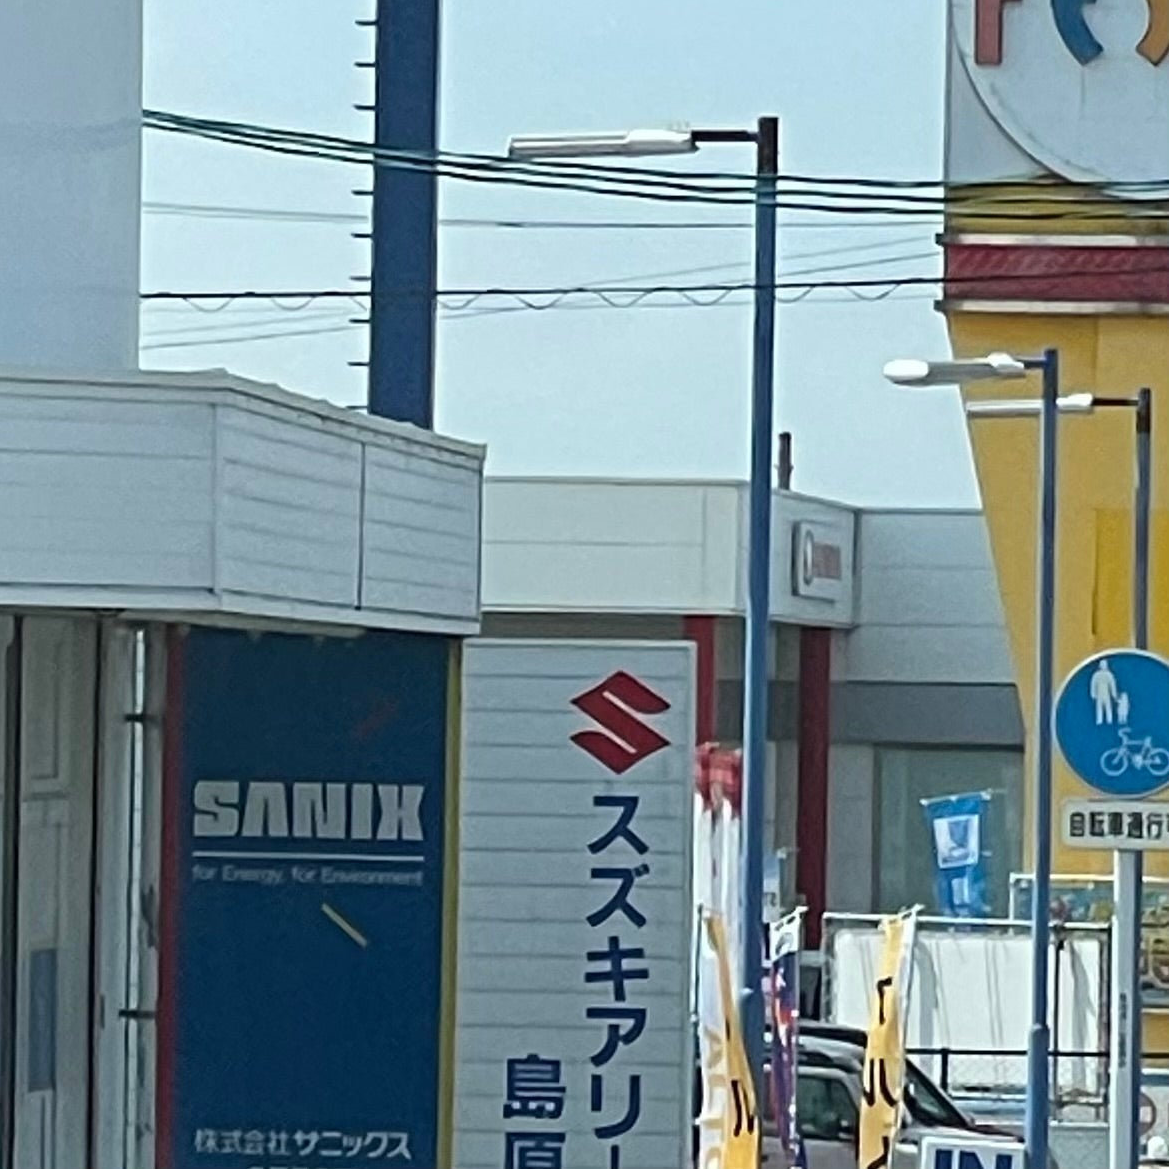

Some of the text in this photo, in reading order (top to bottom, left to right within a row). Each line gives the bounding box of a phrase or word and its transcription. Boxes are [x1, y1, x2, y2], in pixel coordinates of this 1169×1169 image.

[193, 781, 425, 842] SANIX
[1069, 811, 1169, 840] 自転車通行
[194, 1128, 412, 1160] 株式会社サニックス
